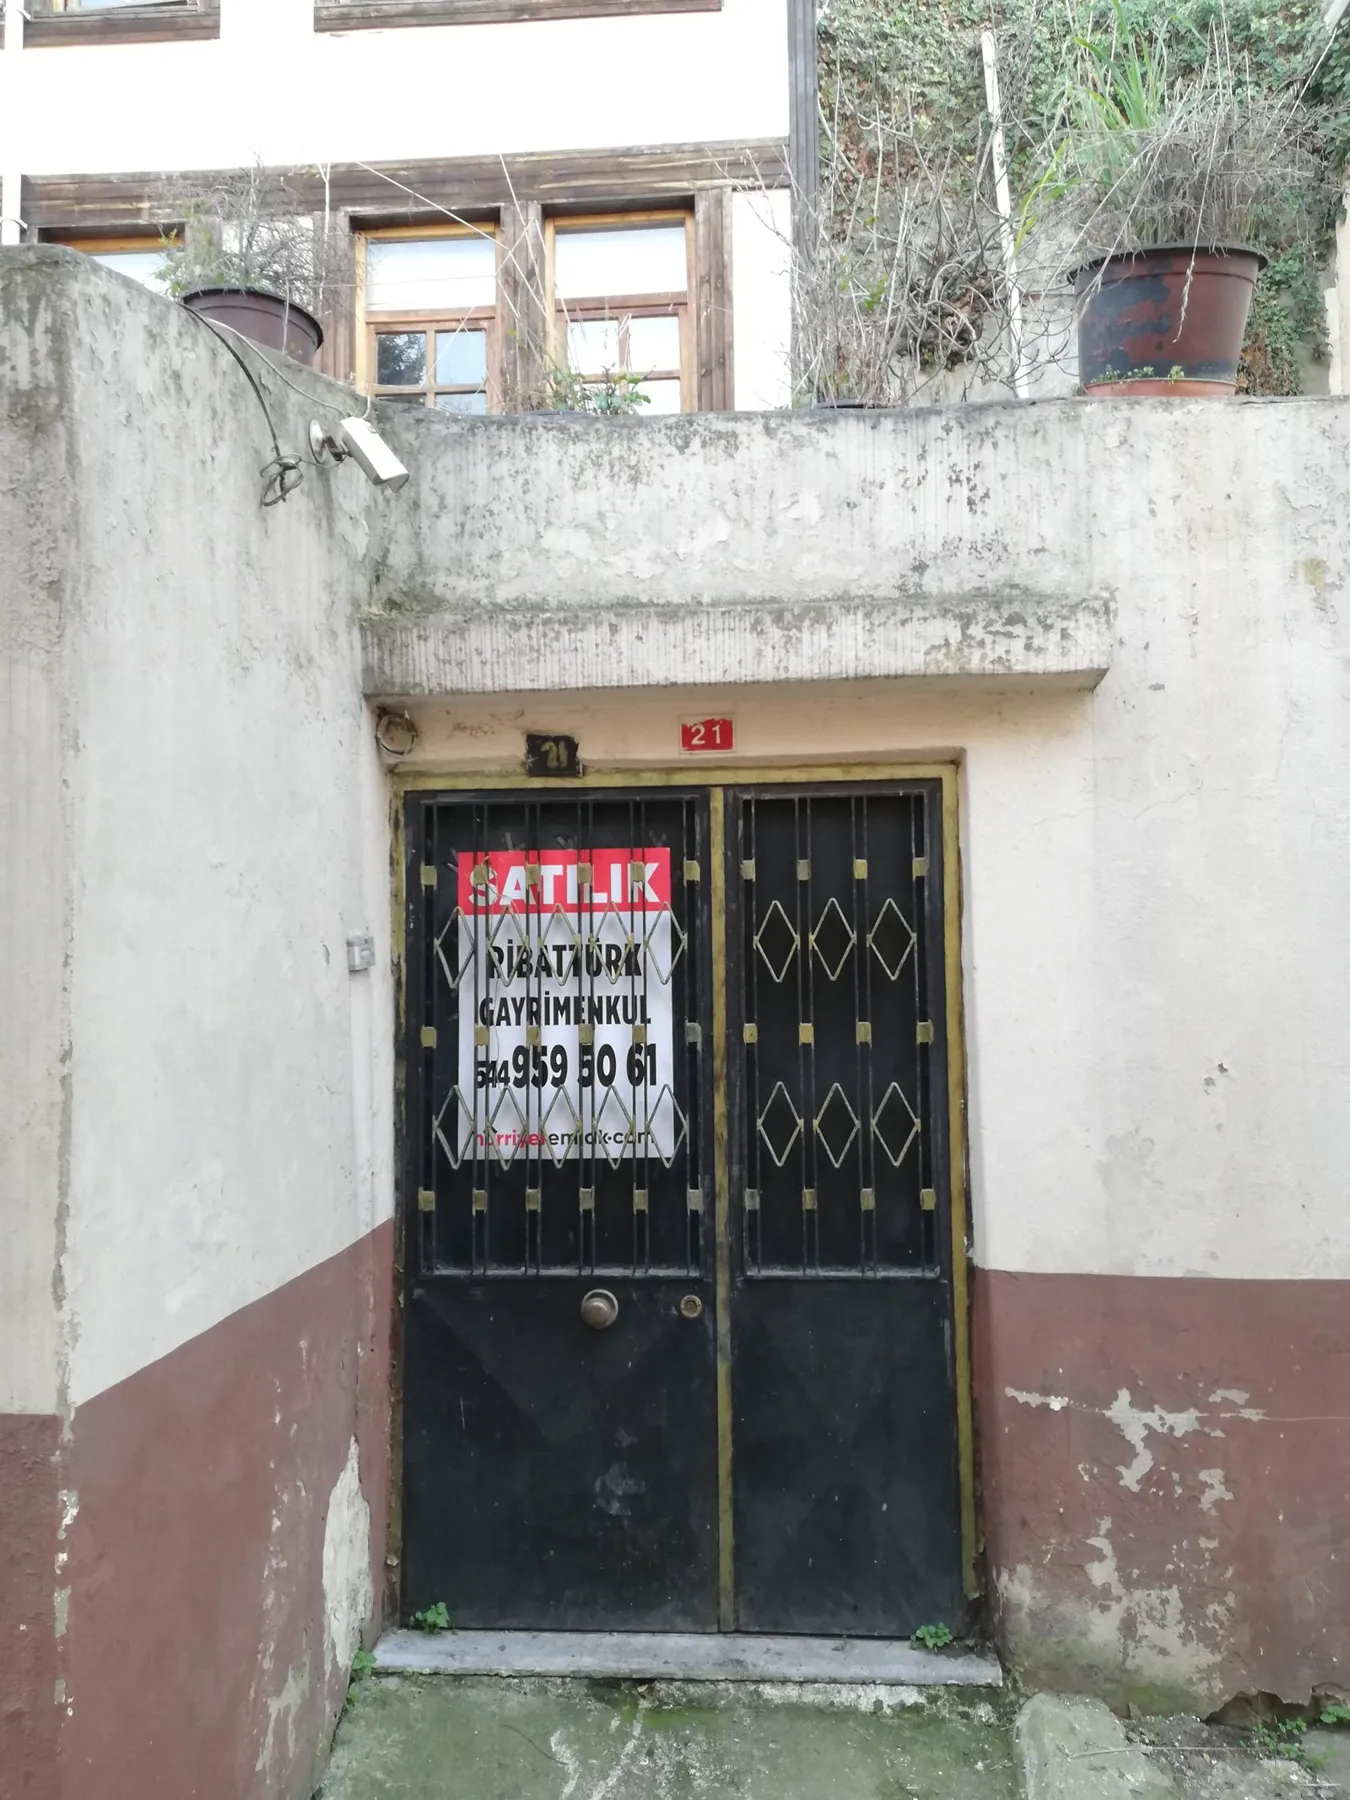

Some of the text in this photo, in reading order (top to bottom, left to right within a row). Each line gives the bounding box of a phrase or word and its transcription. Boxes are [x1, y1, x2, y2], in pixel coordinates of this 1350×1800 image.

[691, 724, 722, 745] 21
[468, 862, 661, 907] SATILIK
[479, 990, 652, 1027] GAYRİMENKUL
[578, 1043, 617, 1088] 50
[626, 1043, 657, 1088] 61
